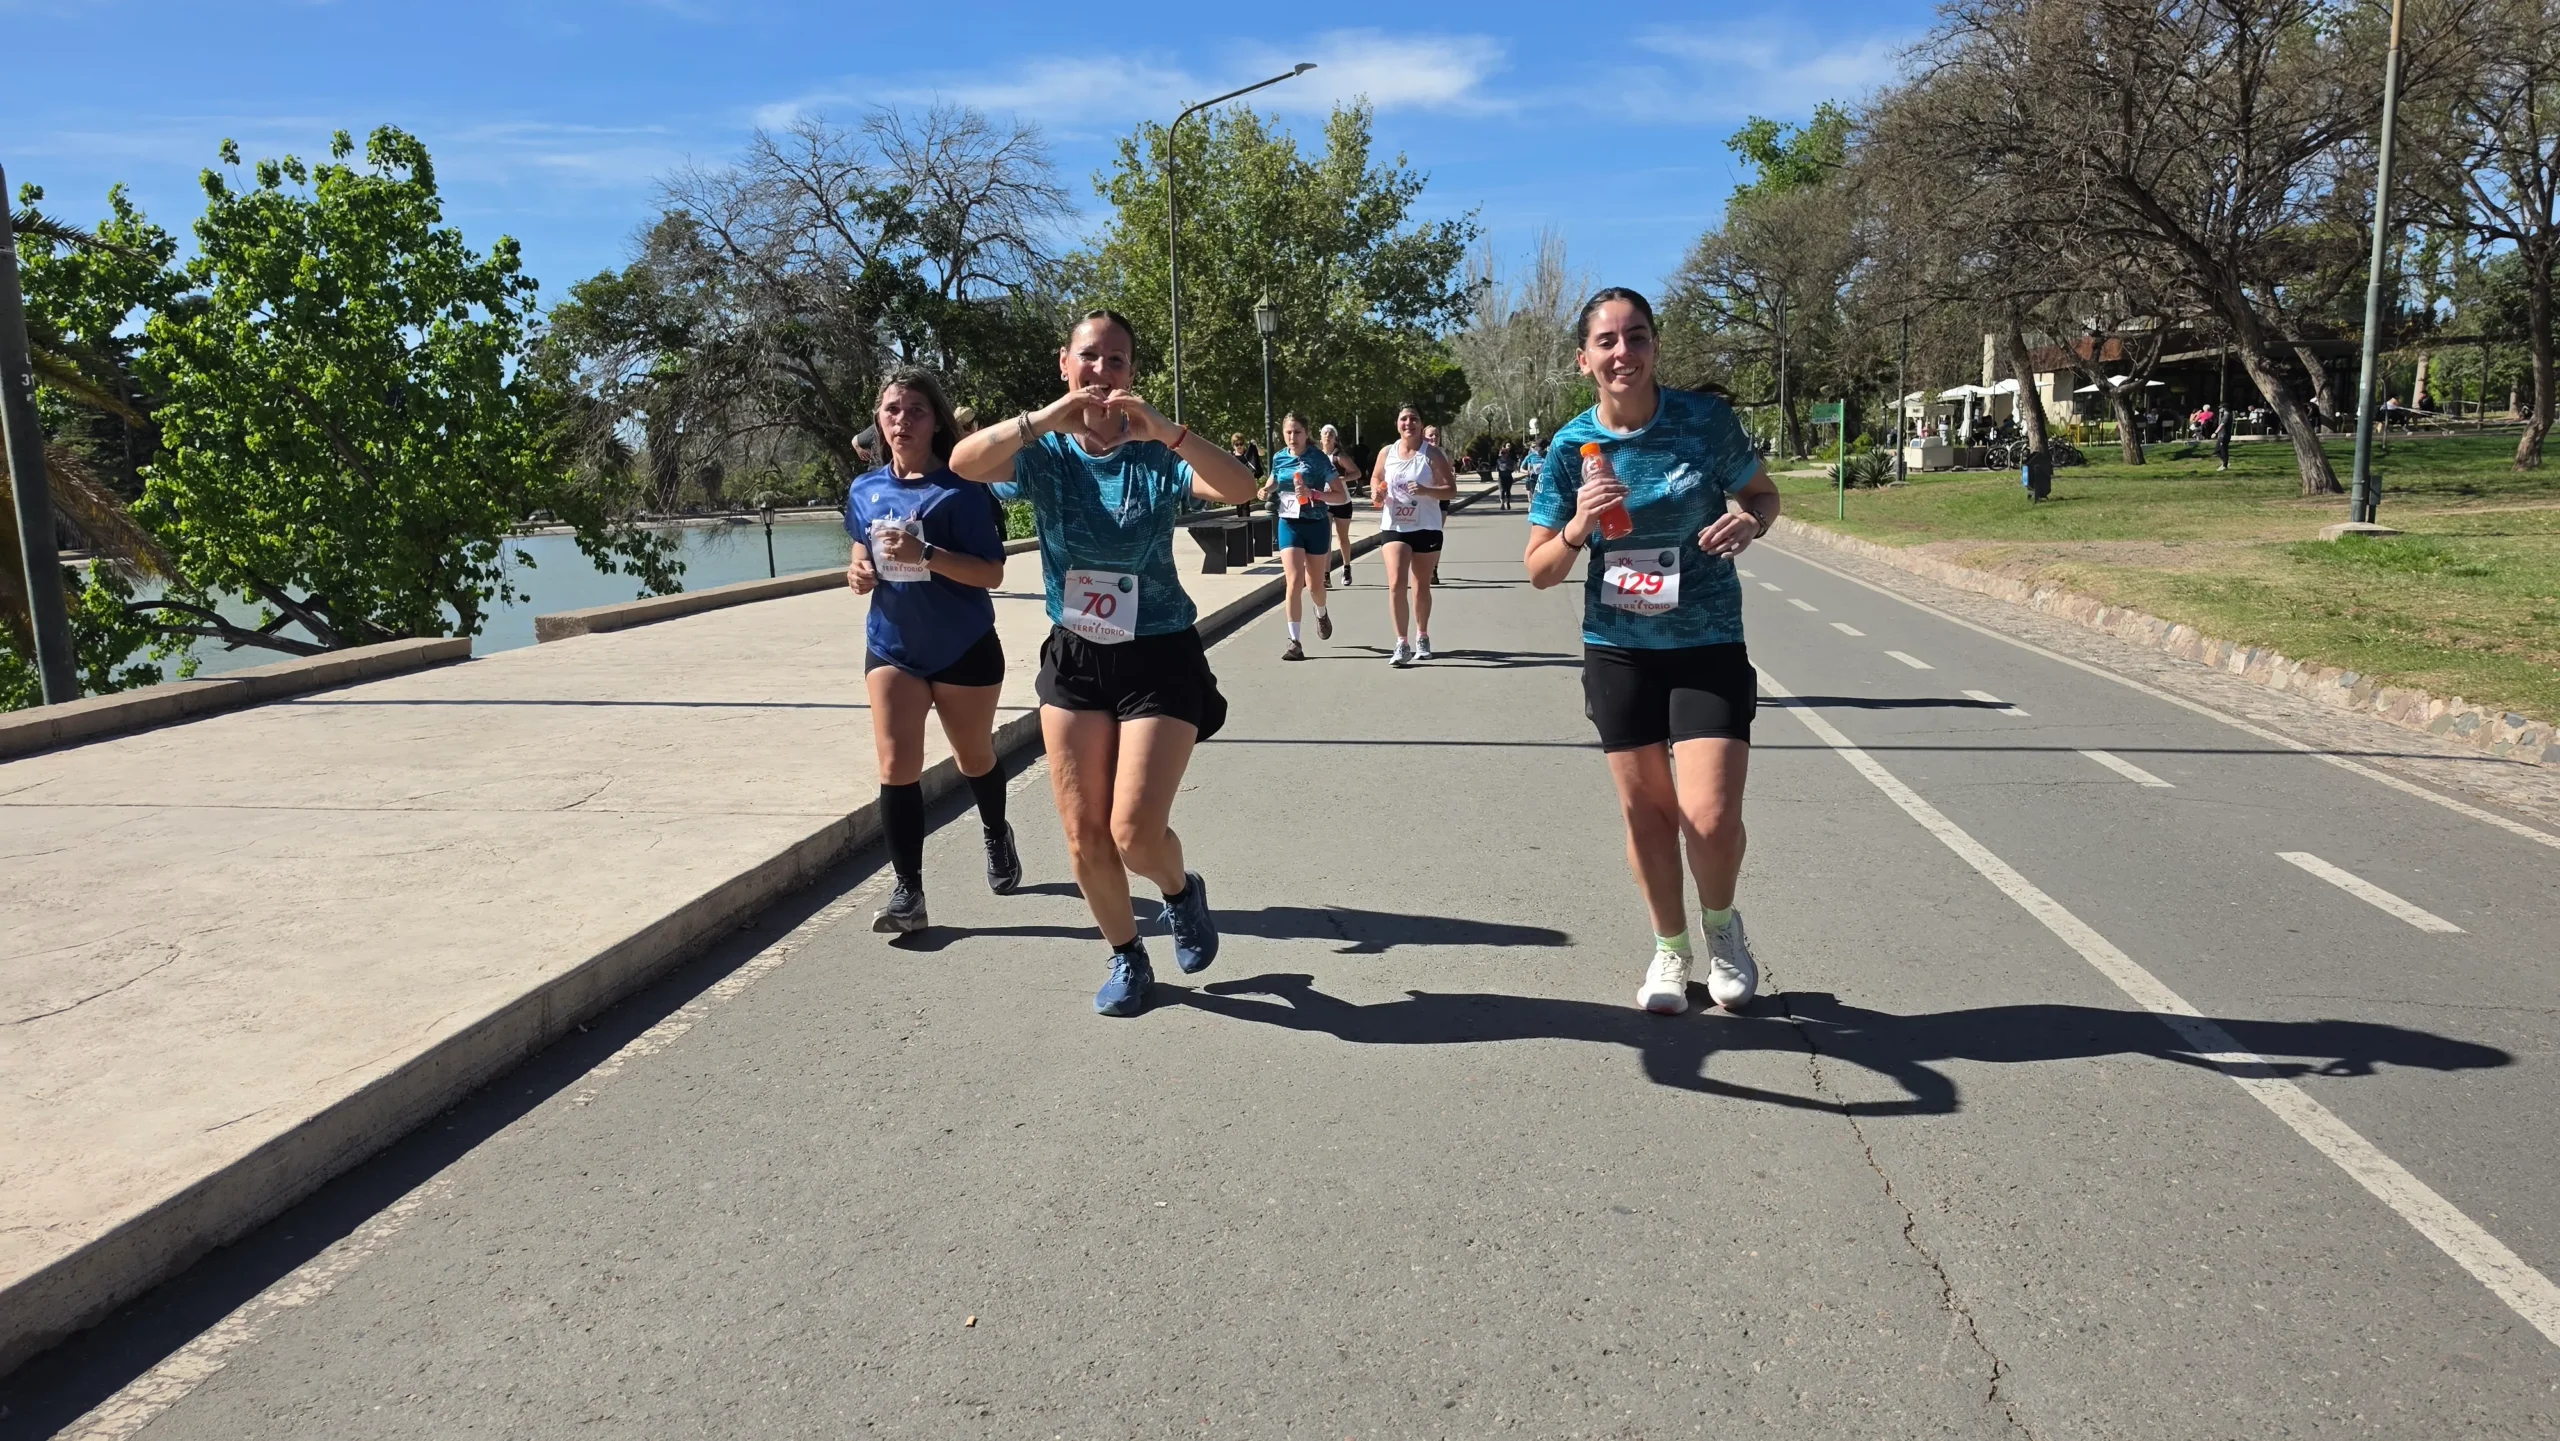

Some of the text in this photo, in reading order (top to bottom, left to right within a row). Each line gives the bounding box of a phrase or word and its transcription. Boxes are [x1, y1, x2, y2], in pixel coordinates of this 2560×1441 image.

[1395, 506, 1416, 517] 207
[1078, 576, 1094, 586] 10k
[1617, 570, 1664, 595] 129
[1081, 591, 1117, 619] 70
[1072, 621, 1125, 637] TERRITORIO
